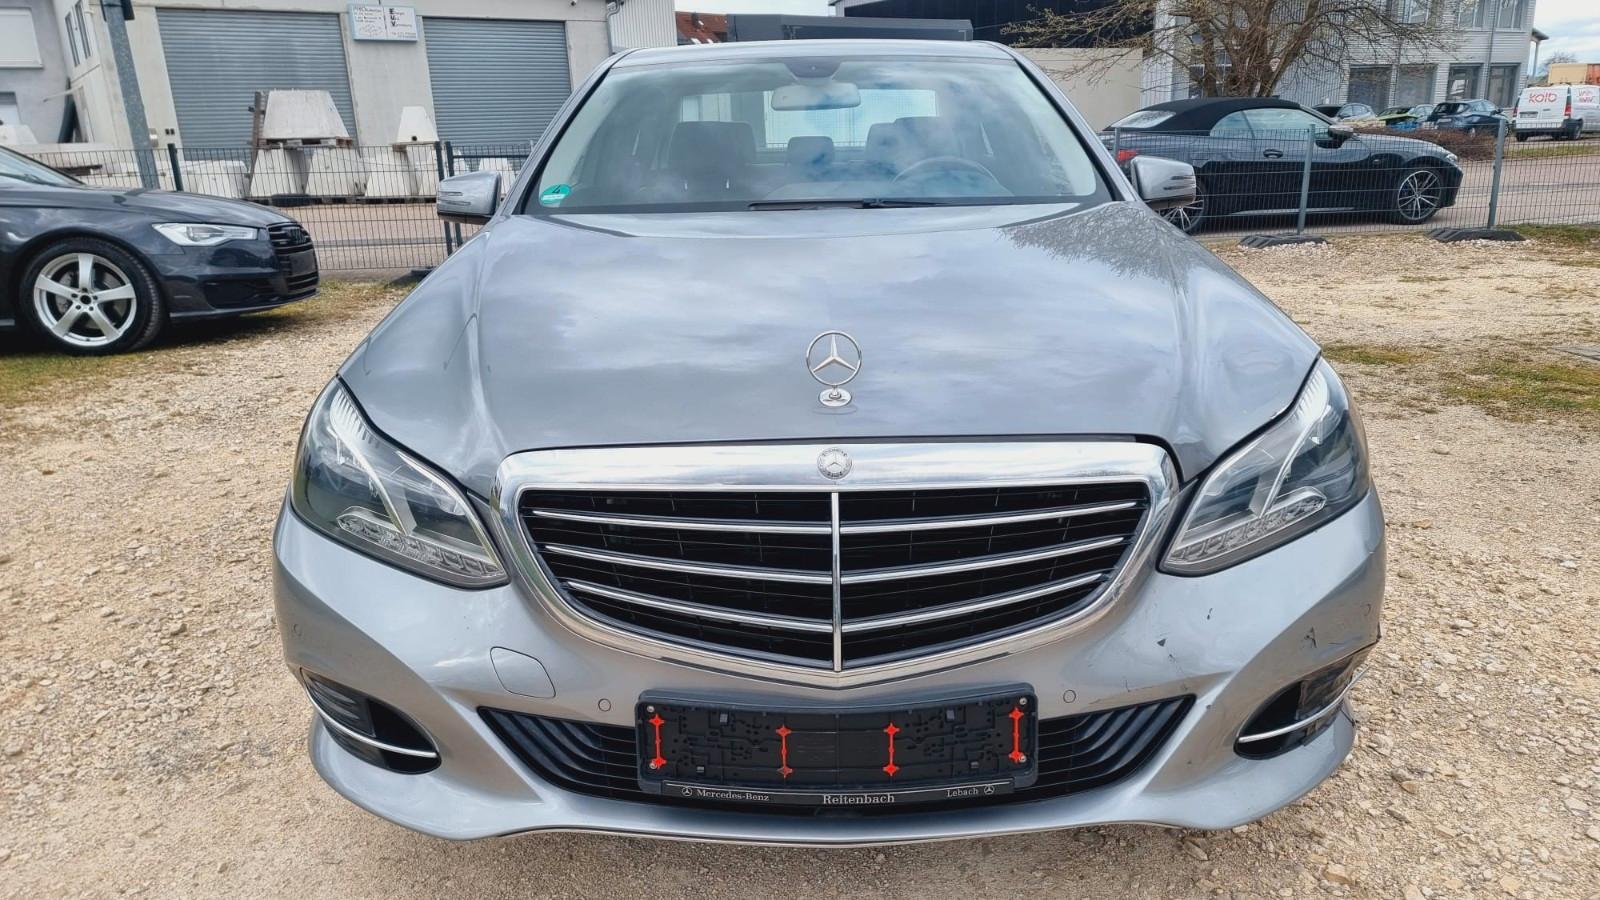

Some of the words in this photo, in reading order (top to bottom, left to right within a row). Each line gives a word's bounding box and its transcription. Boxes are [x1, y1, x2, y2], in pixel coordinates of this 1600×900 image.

[696, 788, 770, 802] Mercedes-Benz
[822, 793, 895, 805] Reitenbach
[947, 787, 979, 798] Lebach
